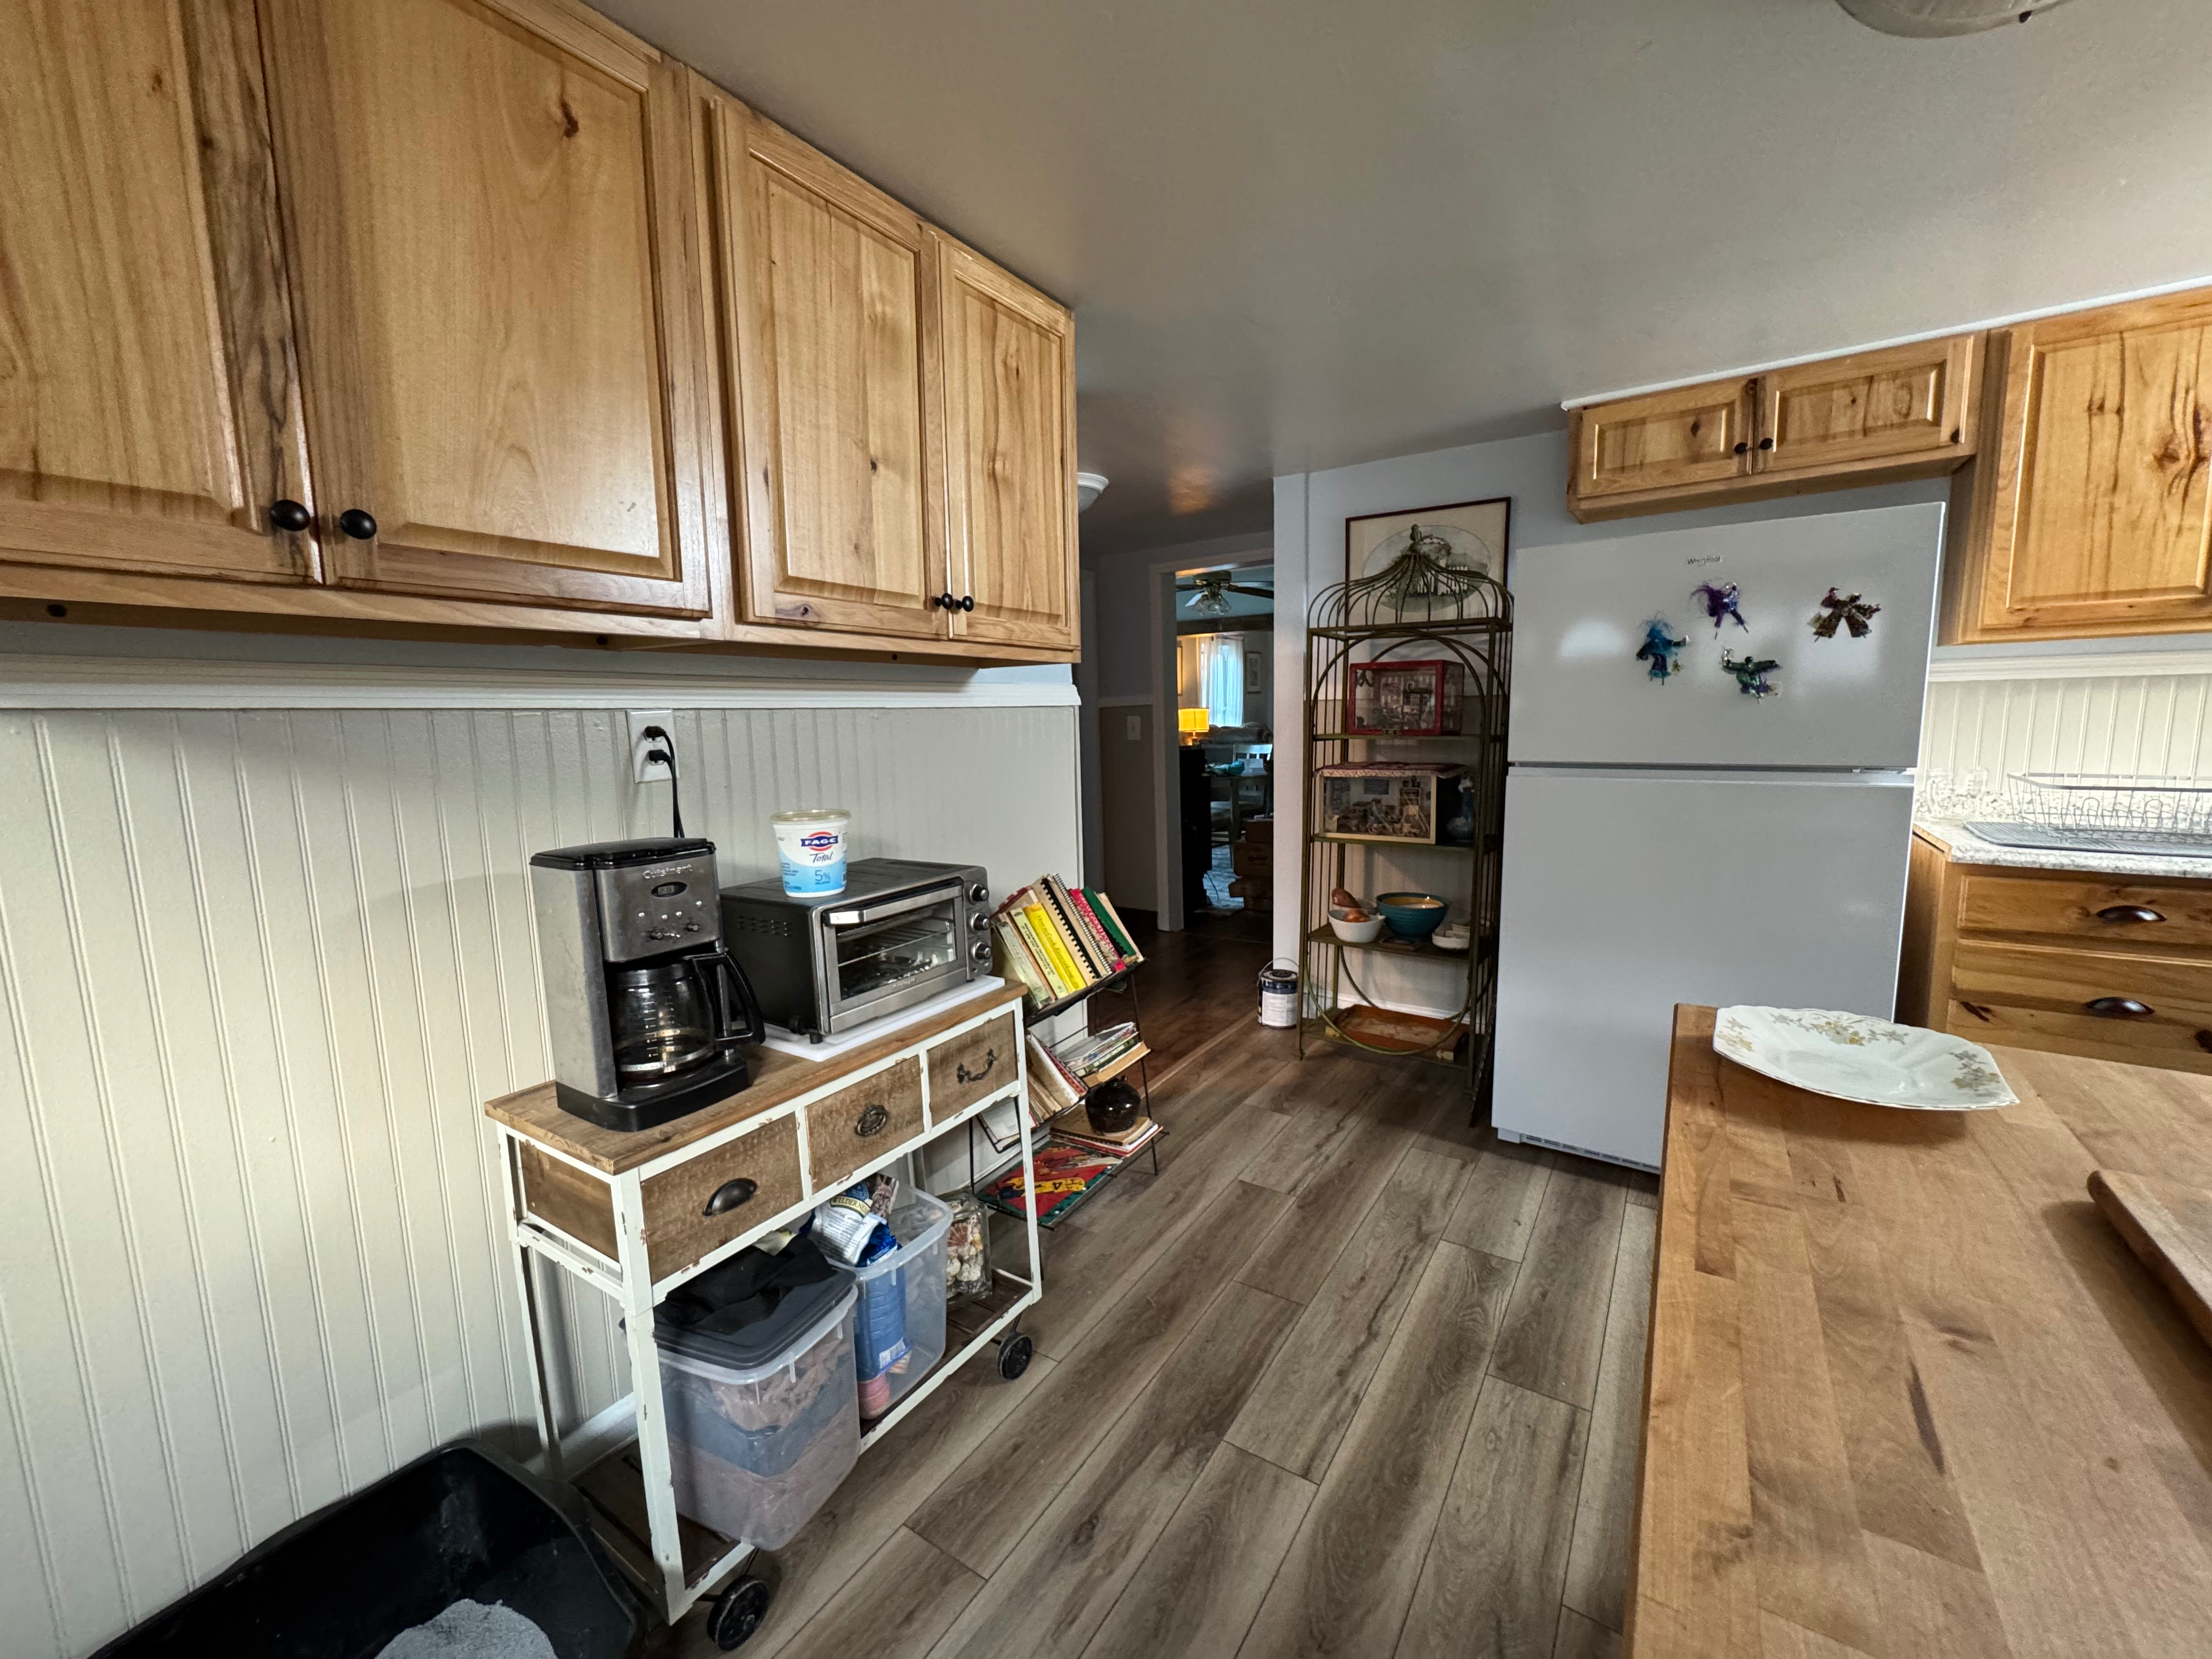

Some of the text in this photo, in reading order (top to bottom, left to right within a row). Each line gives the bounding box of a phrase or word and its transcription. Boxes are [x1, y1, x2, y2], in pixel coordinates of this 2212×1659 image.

[809, 851, 833, 864] Total
[815, 870, 831, 882] 5%
[1088, 911, 1104, 932] GOOD
